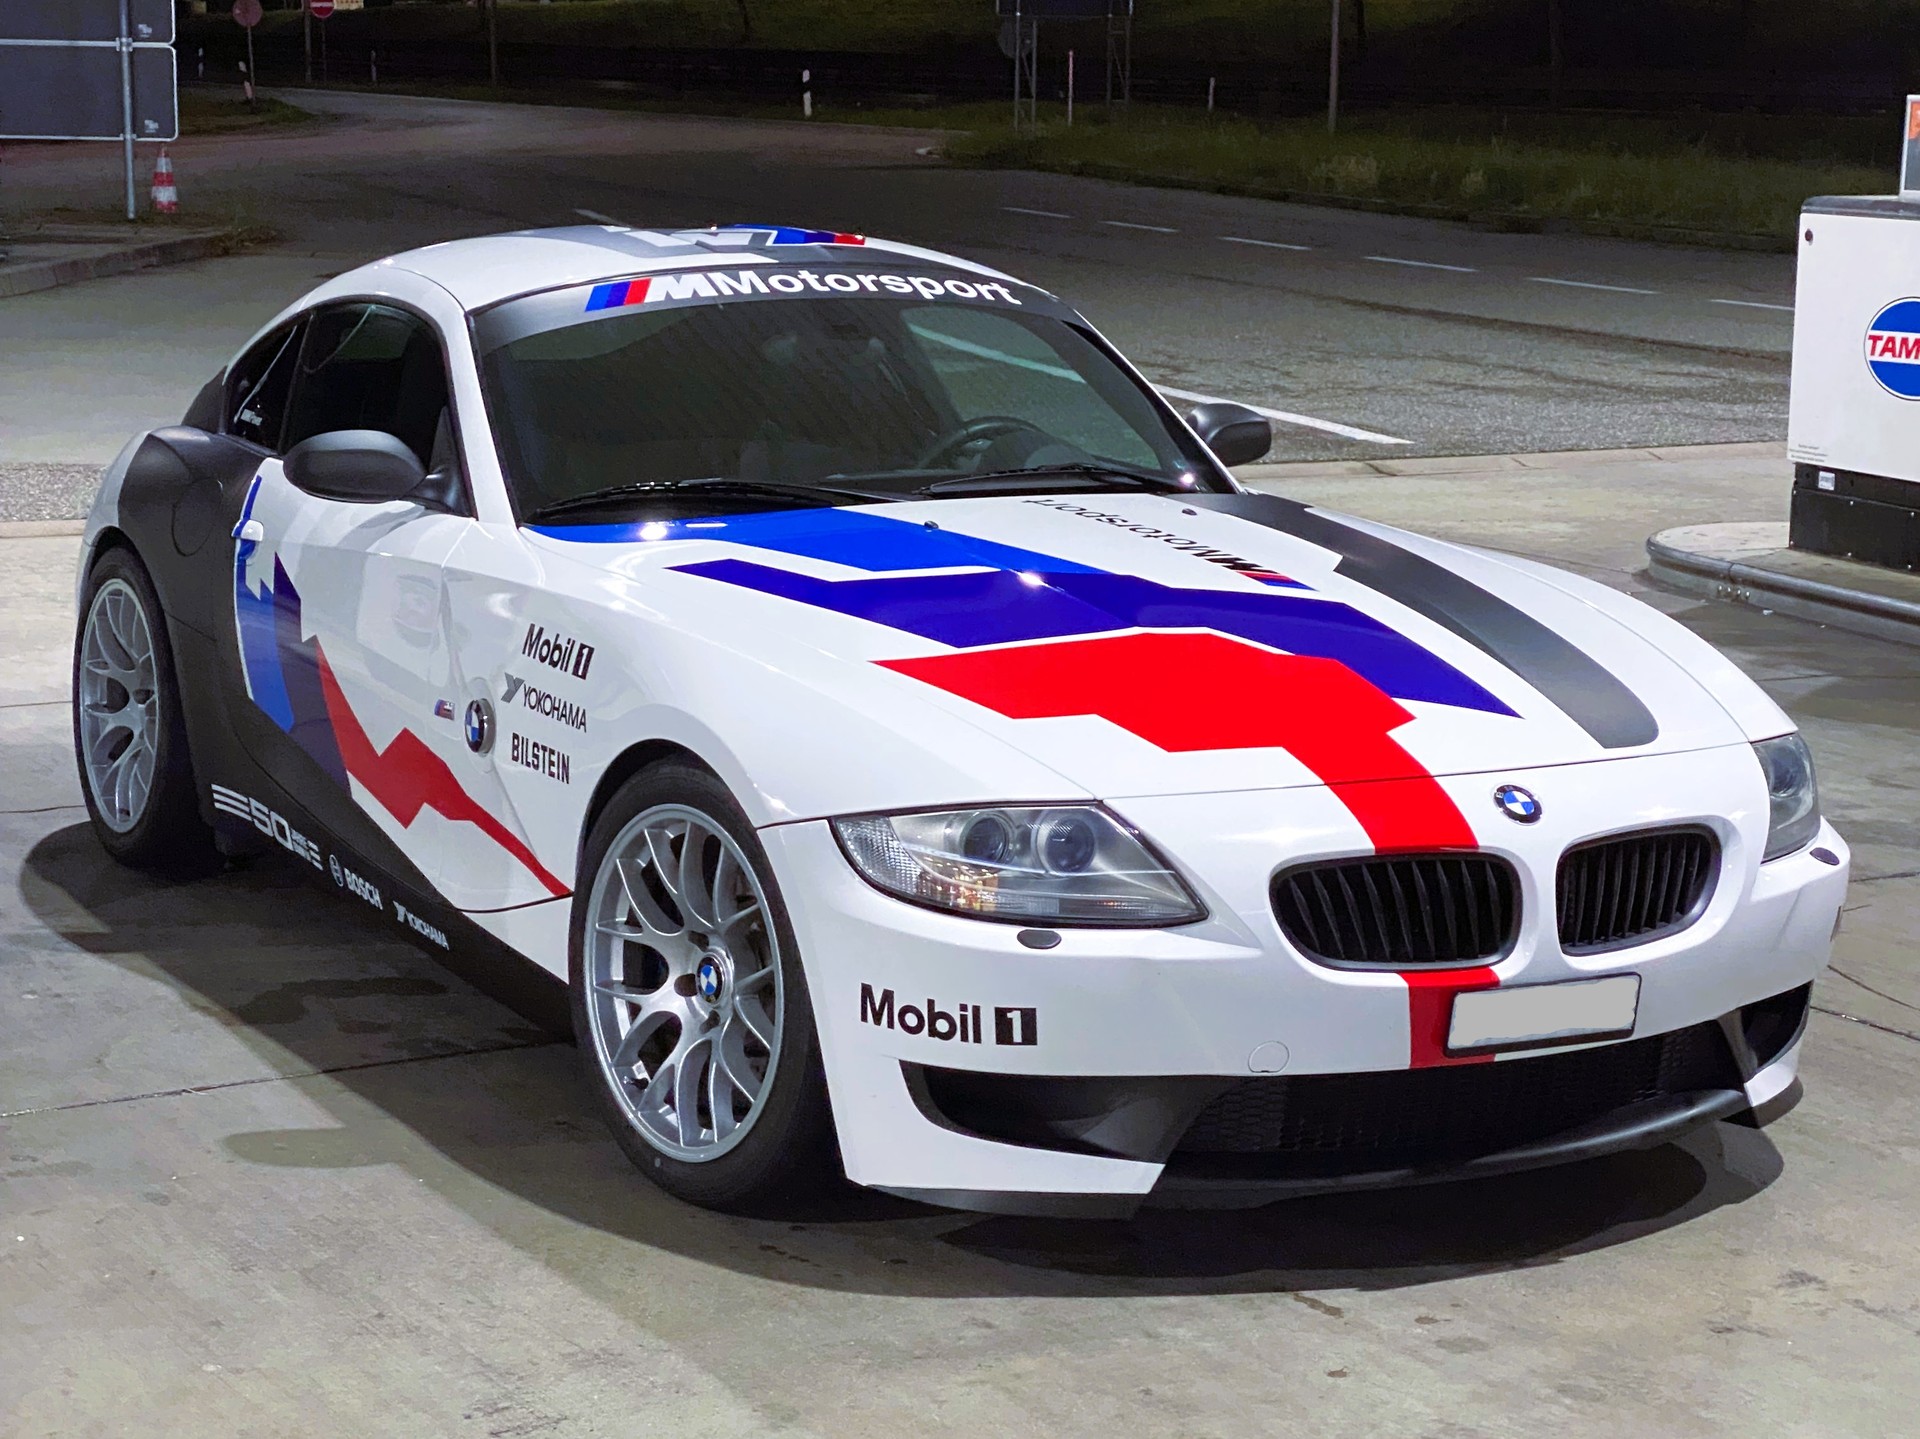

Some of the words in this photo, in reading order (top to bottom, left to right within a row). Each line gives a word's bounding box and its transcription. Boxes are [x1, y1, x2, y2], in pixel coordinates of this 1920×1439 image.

[707, 269, 1023, 305] Motorsport
[1021, 498, 1234, 558] Motorsport
[522, 623, 576, 673] Mobil
[523, 683, 587, 733] YOKOHAMA
[511, 732, 570, 784] BILSTEIN
[344, 867, 383, 910] BOSCH
[860, 982, 982, 1044] Mobil
